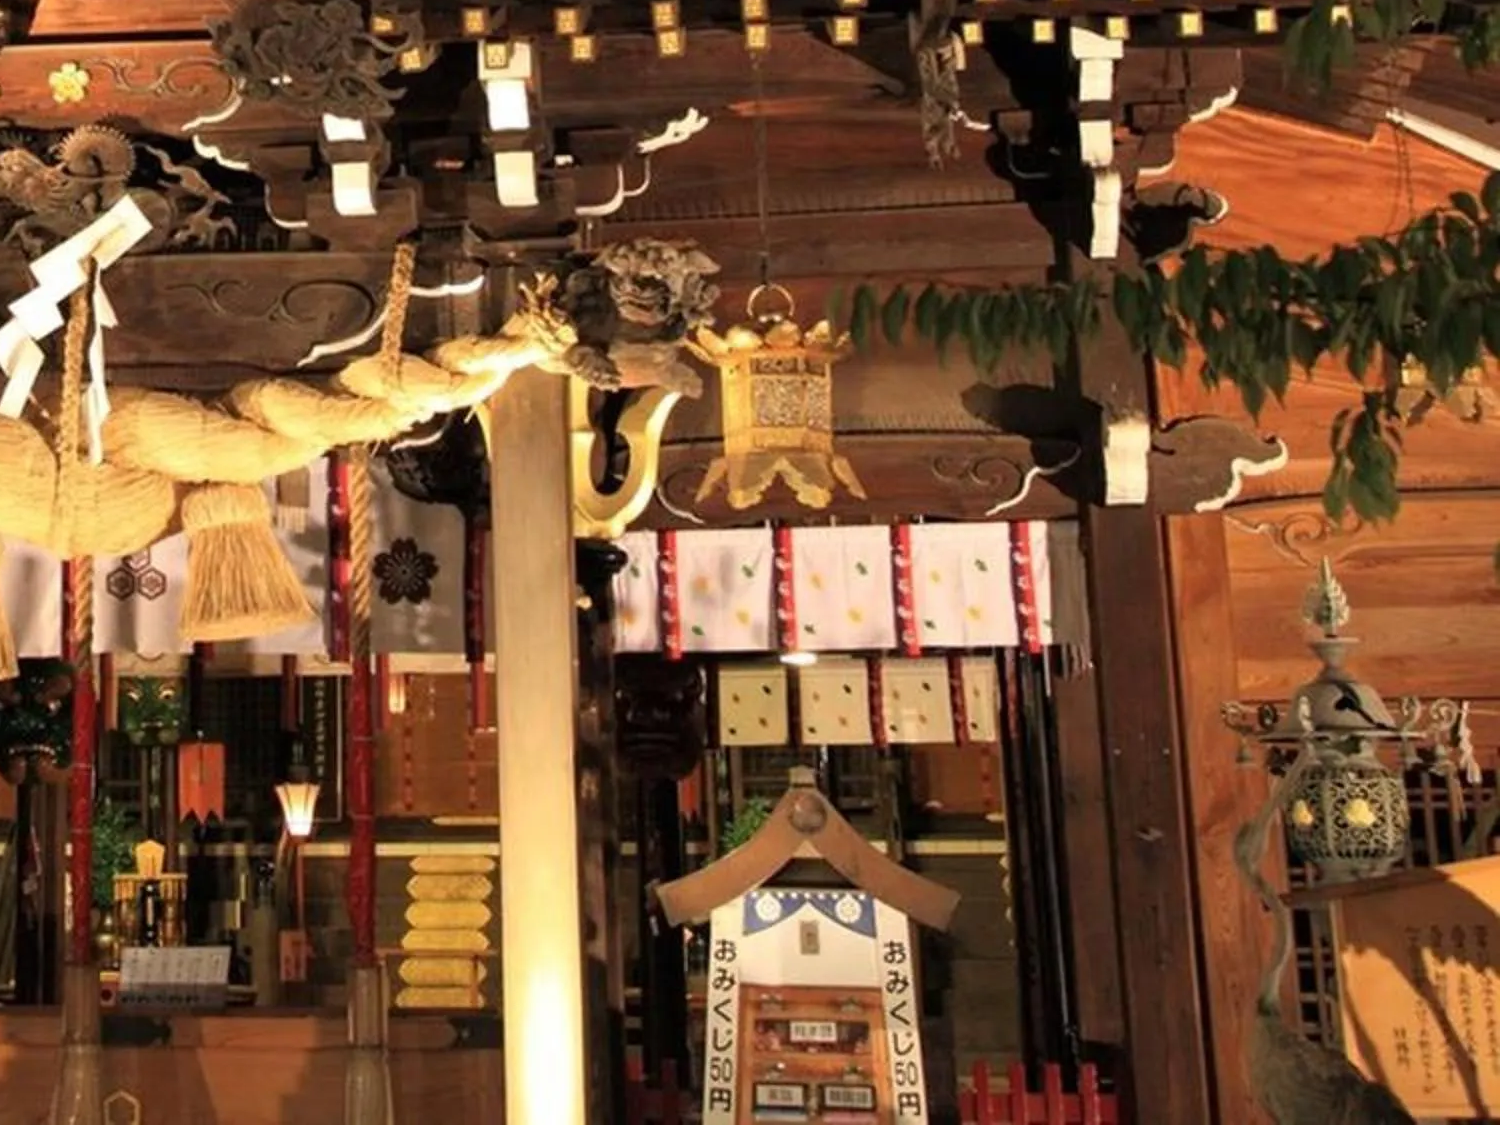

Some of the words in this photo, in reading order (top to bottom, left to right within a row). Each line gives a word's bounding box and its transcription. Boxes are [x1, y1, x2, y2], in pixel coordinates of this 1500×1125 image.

[709, 939, 737, 1112] おみくじ50円
[884, 940, 922, 1116] おみくじ50円
